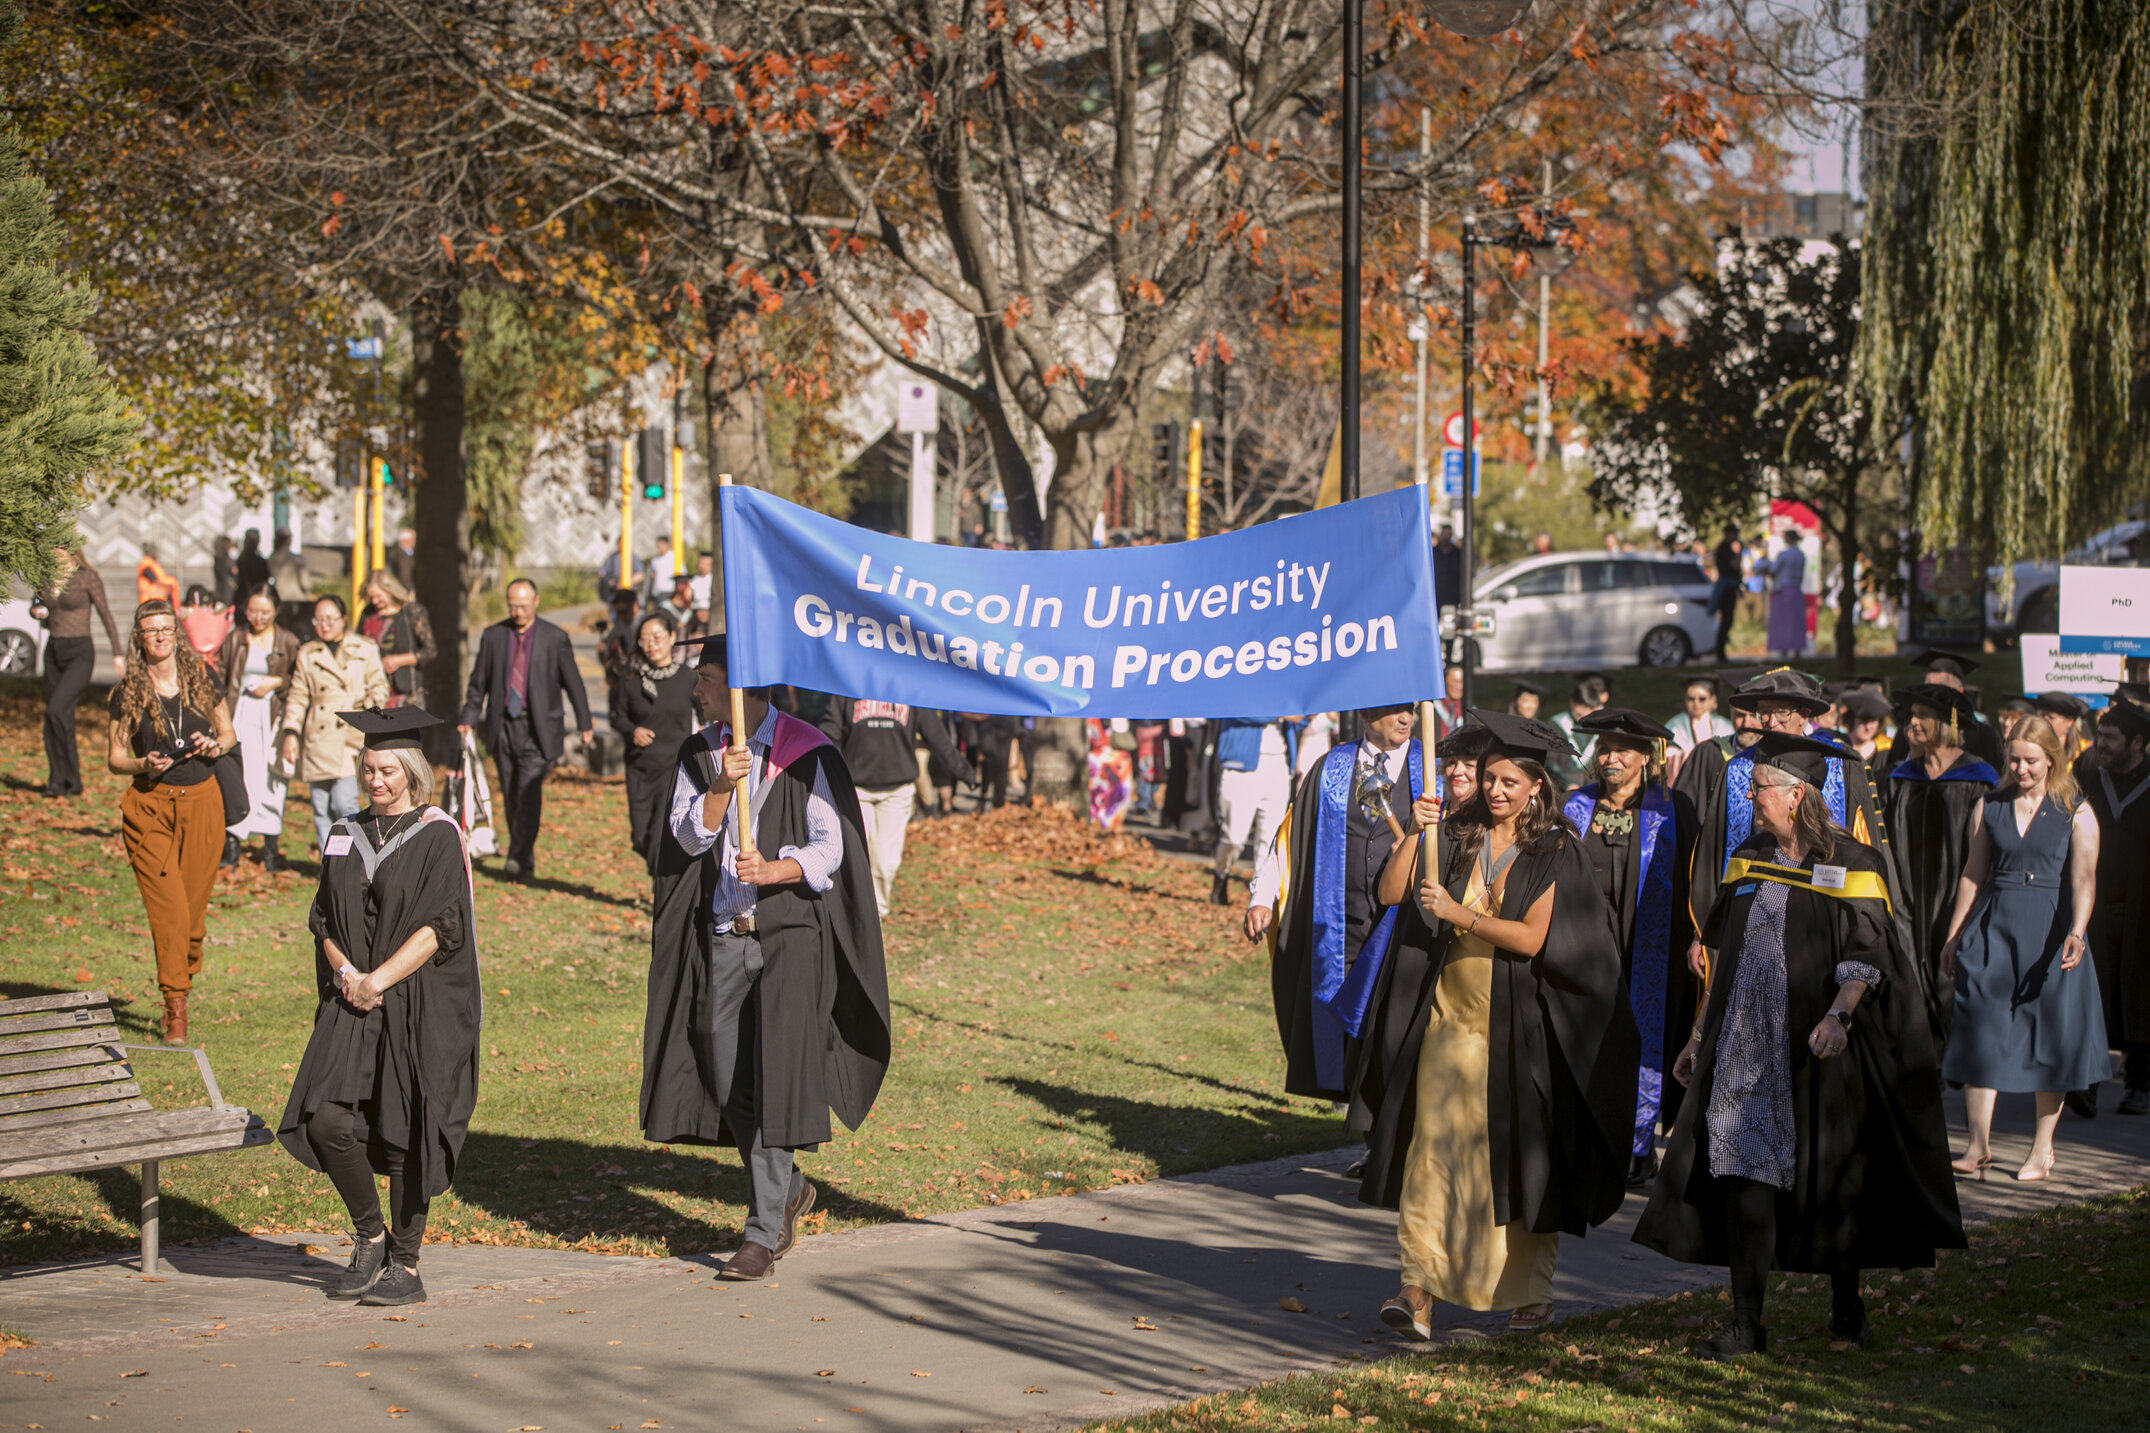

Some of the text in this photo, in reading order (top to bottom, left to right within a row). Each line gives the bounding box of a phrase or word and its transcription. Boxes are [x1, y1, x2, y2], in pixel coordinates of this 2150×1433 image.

[857, 553, 1331, 629] Lincoln University
[2111, 598, 2132, 607] PhD
[794, 594, 1398, 689] Graduation Procession
[2054, 661, 2093, 671] Applied
[2045, 672, 2103, 683] Computing
